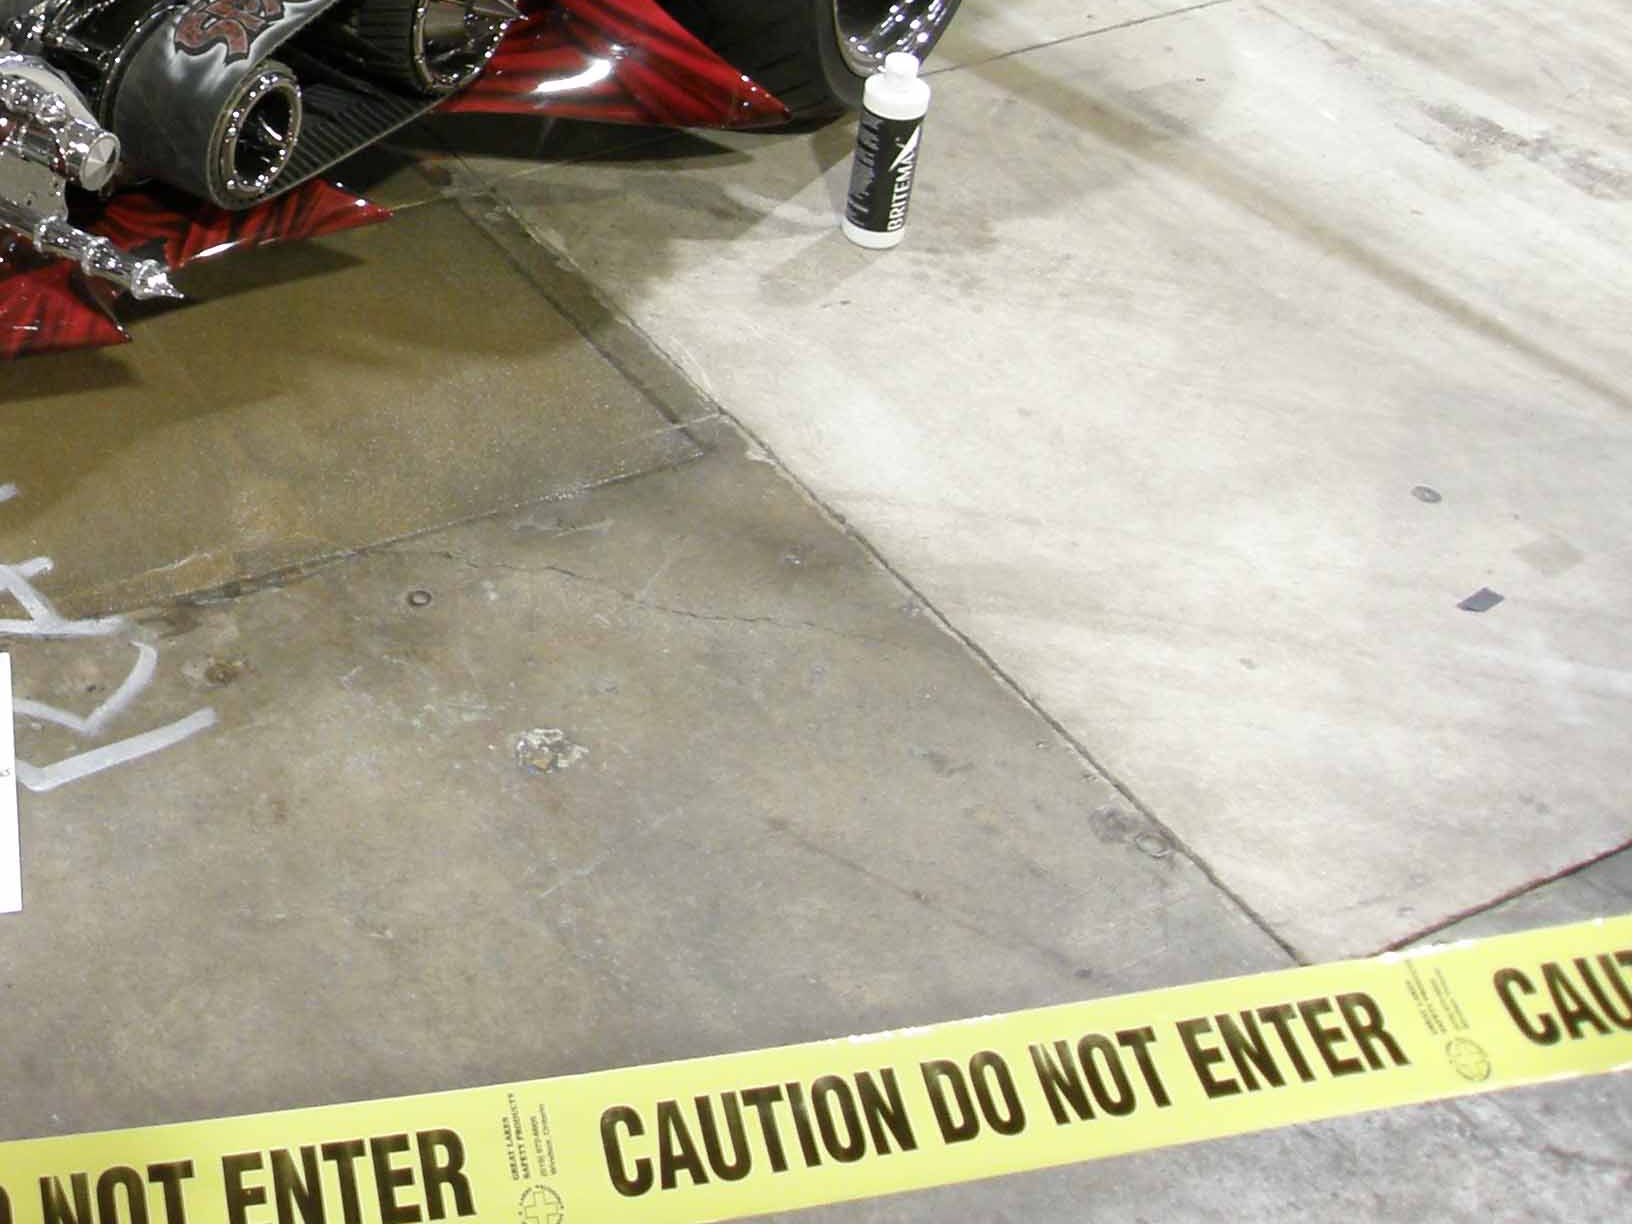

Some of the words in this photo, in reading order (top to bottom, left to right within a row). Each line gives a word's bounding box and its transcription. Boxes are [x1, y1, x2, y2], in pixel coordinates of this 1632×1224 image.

[600, 1067, 919, 1198] CAUTION
[919, 1050, 1028, 1145] DO
[1028, 1025, 1172, 1125] NOT
[1175, 991, 1413, 1099] ENTER
[39, 1160, 195, 1224] NOT
[222, 1129, 477, 1224] ENTER
